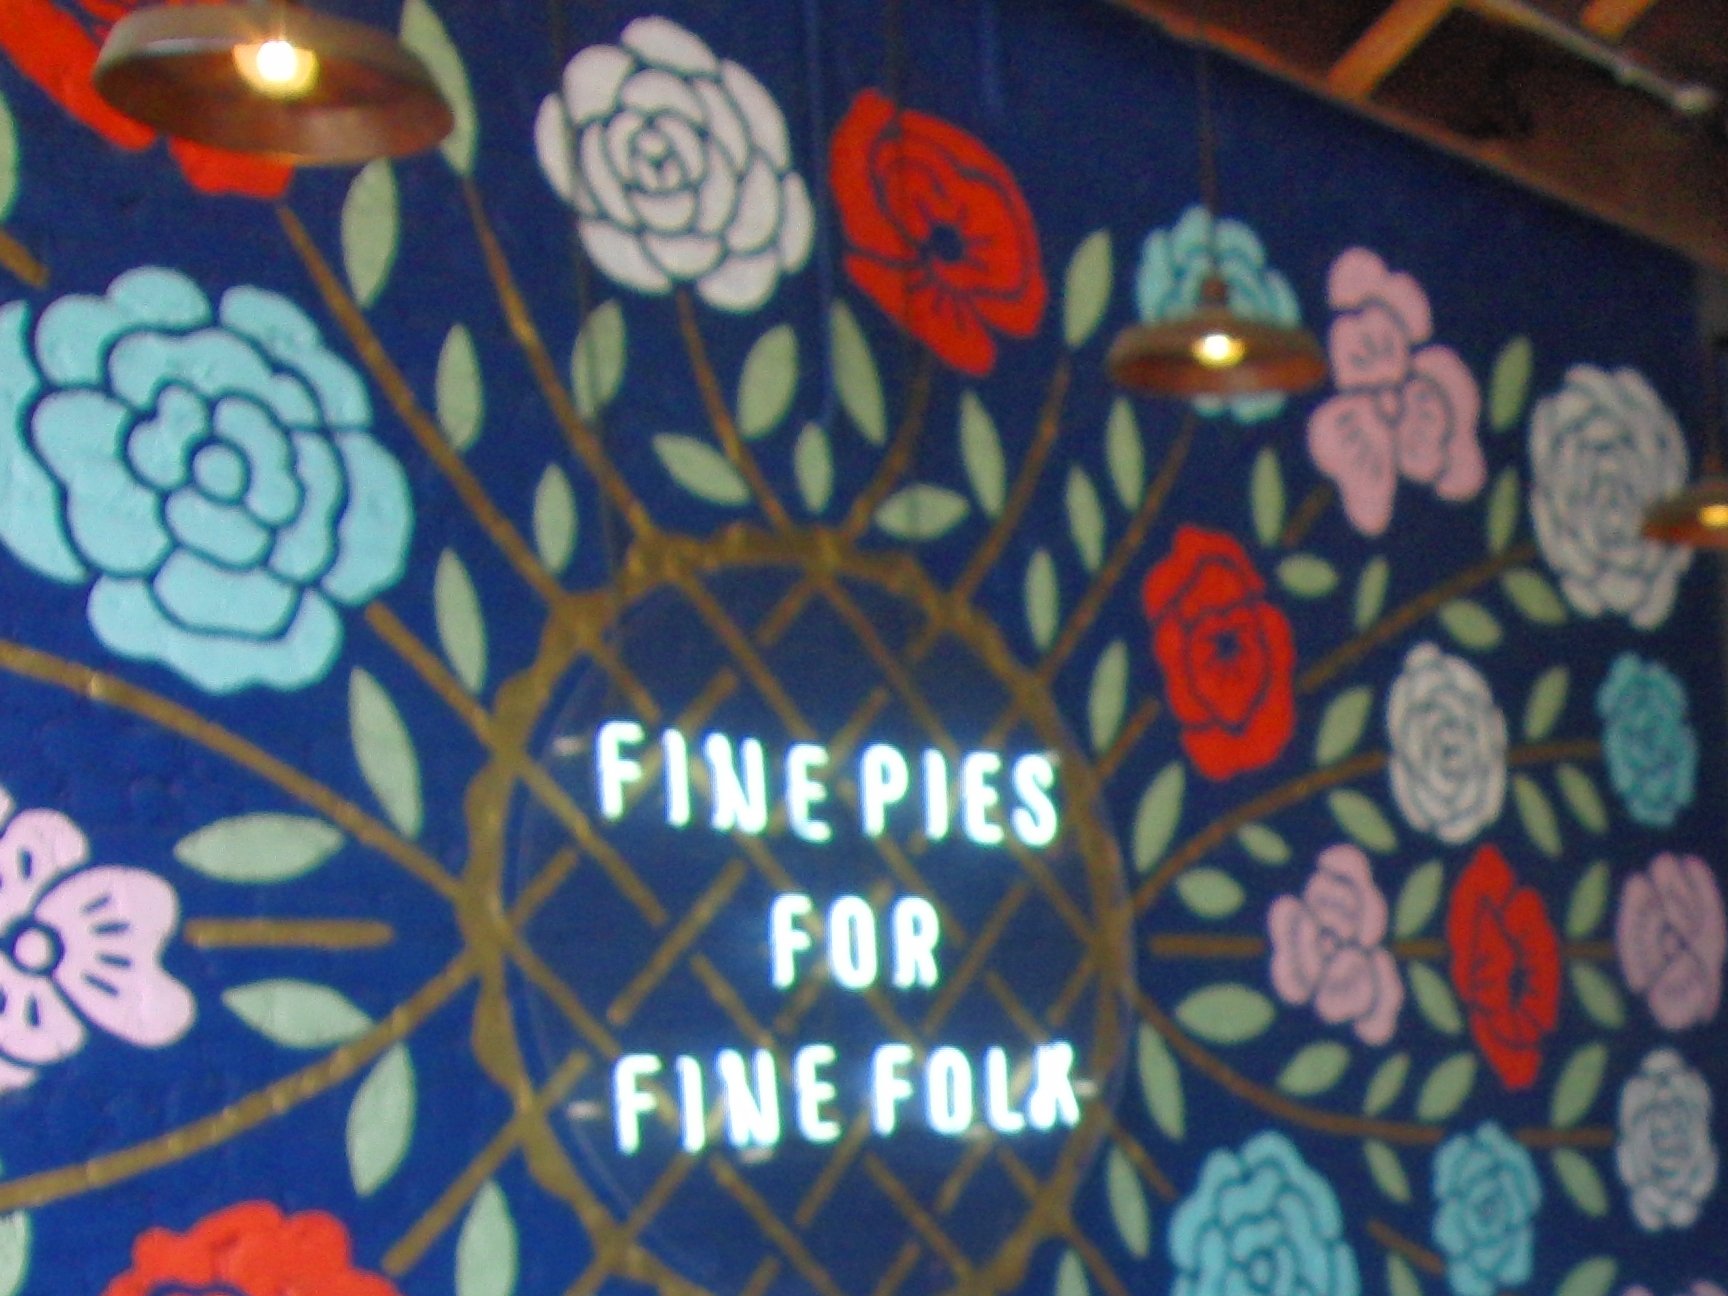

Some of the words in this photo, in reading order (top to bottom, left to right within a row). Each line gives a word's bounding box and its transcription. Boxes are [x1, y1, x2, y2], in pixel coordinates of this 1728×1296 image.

[595, 720, 833, 843] FINE
[859, 743, 1059, 848] PIES
[770, 893, 941, 990] FOR
[613, 1042, 841, 1156] FINE
[868, 1040, 1081, 1138] FOLK
